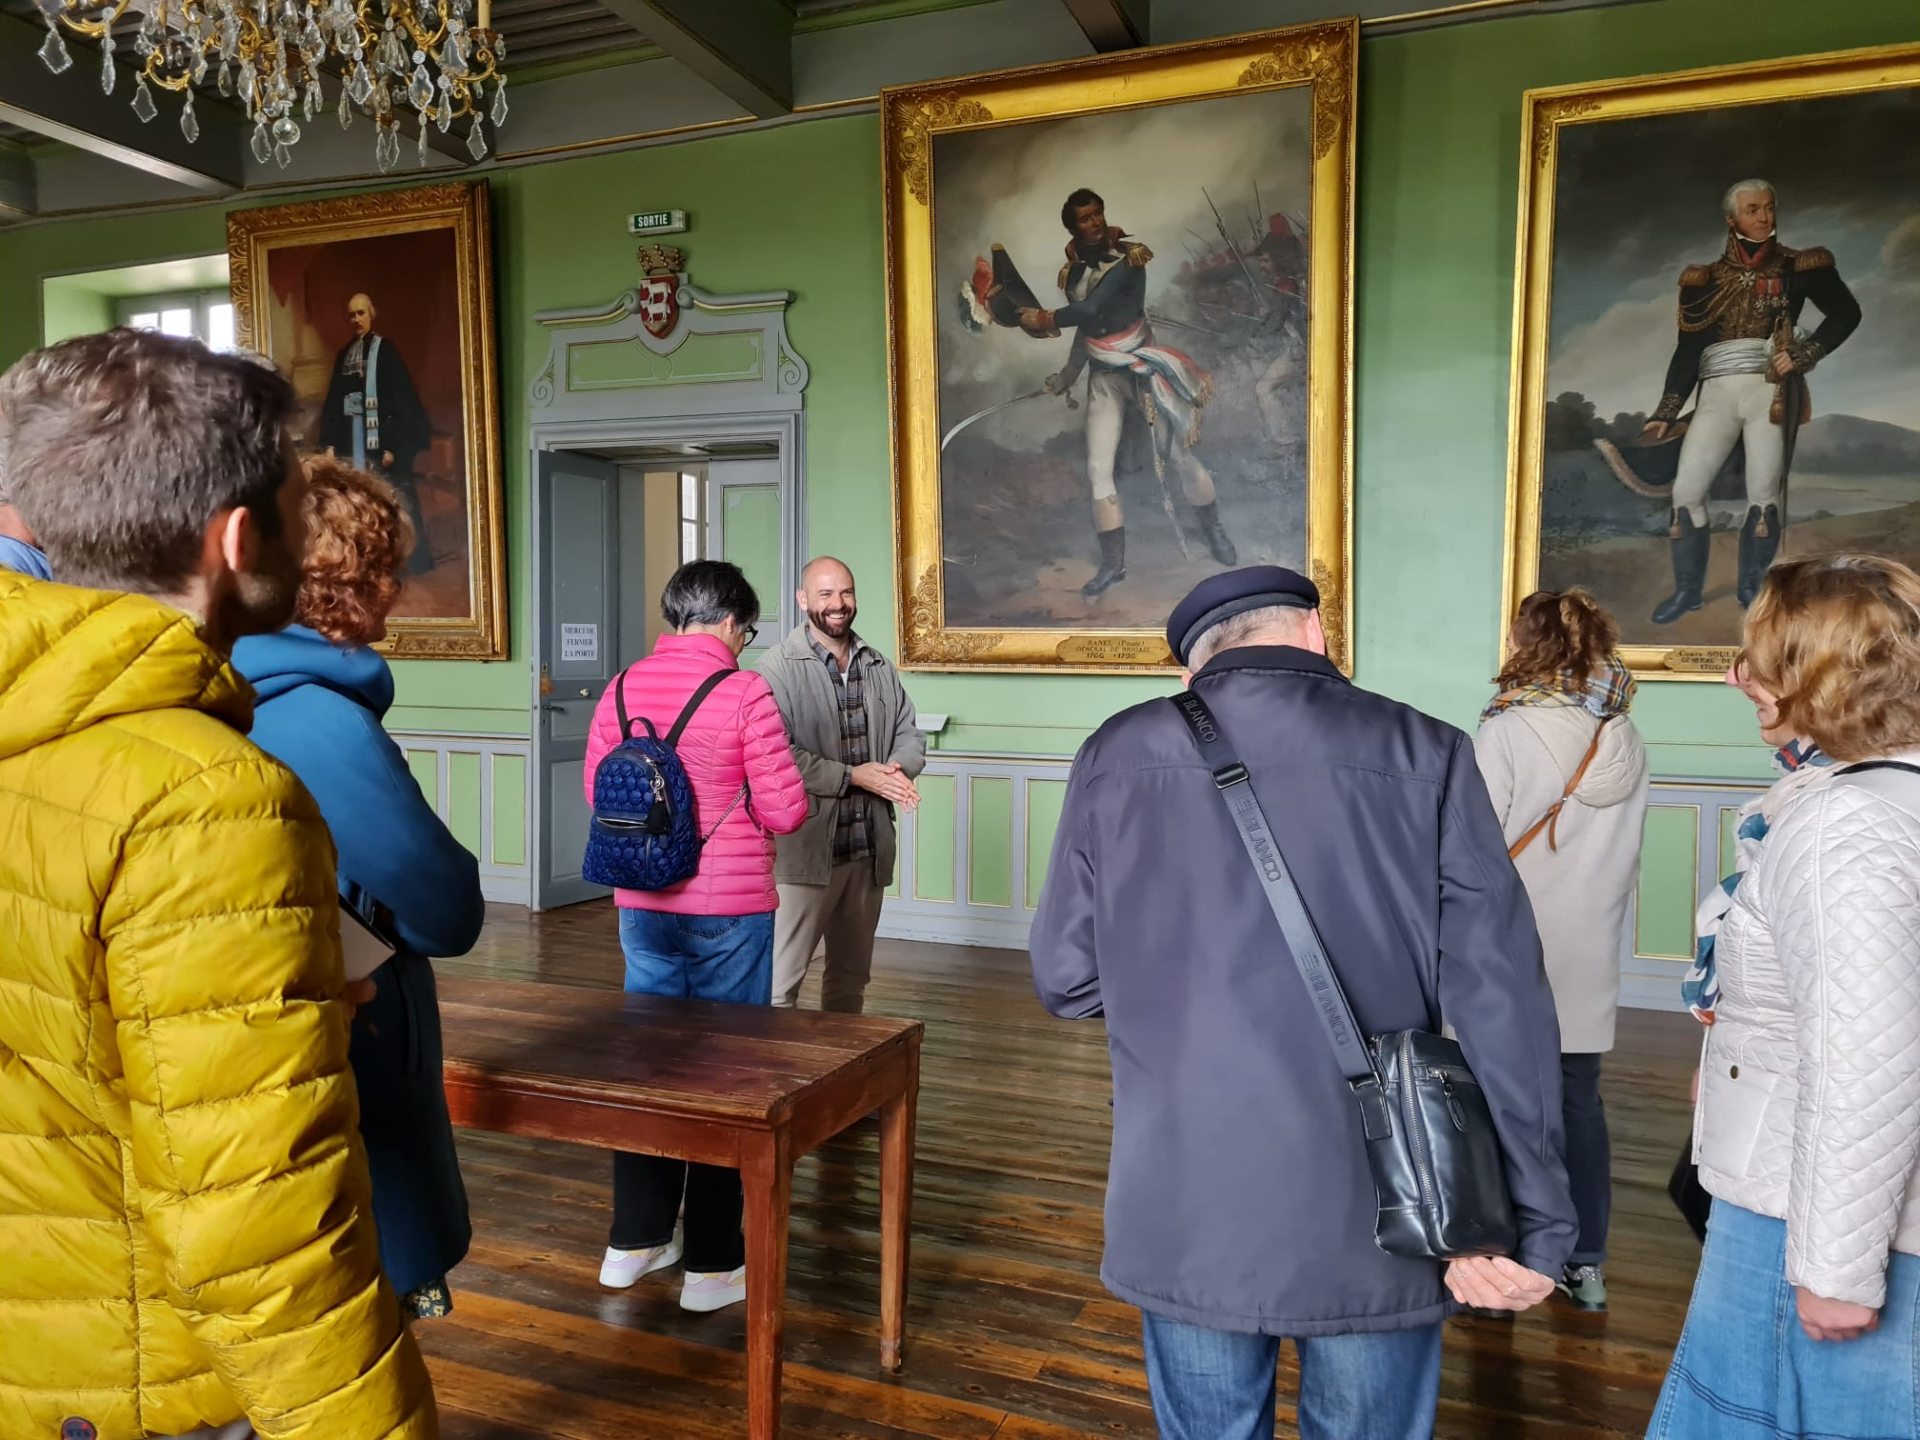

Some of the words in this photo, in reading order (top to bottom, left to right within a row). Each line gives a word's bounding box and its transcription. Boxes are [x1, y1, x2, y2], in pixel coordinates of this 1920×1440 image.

[638, 213, 668, 227] SORTIE
[1183, 699, 1217, 742] BLANCO
[1245, 816, 1281, 882] BLANCO
